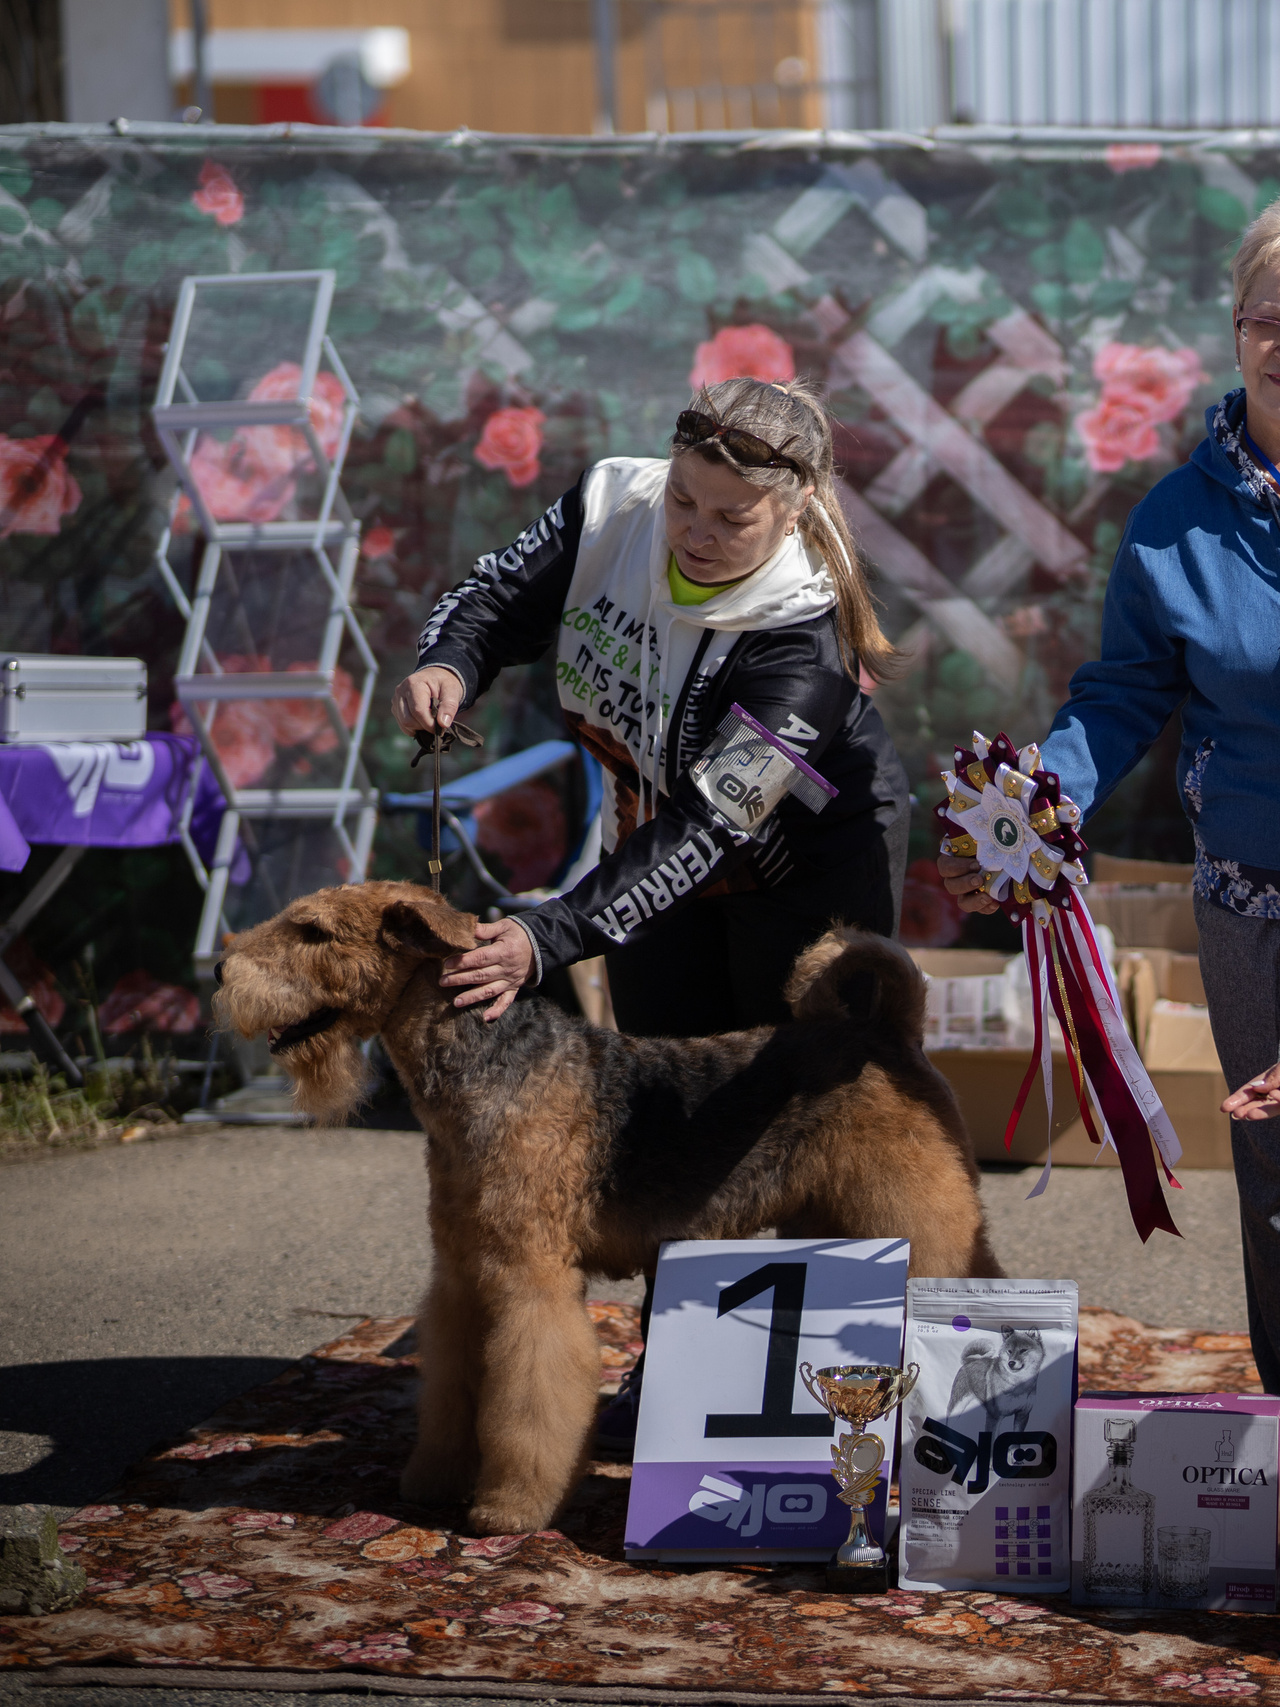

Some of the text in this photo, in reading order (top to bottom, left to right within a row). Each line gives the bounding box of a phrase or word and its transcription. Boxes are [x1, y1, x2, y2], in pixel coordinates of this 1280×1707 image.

[576, 644, 593, 673] IT
[592, 663, 613, 692] IS
[612, 644, 629, 670] &
[556, 660, 598, 707] OPLEY
[591, 829, 724, 945] TERRIER
[704, 1262, 835, 1438] 1
[1139, 1399, 1224, 1409] OPTICA
[1182, 1466, 1269, 1486] OPTICA
[911, 1487, 956, 1497] SPECIAL LINE
[911, 1497, 941, 1508] SENSE
